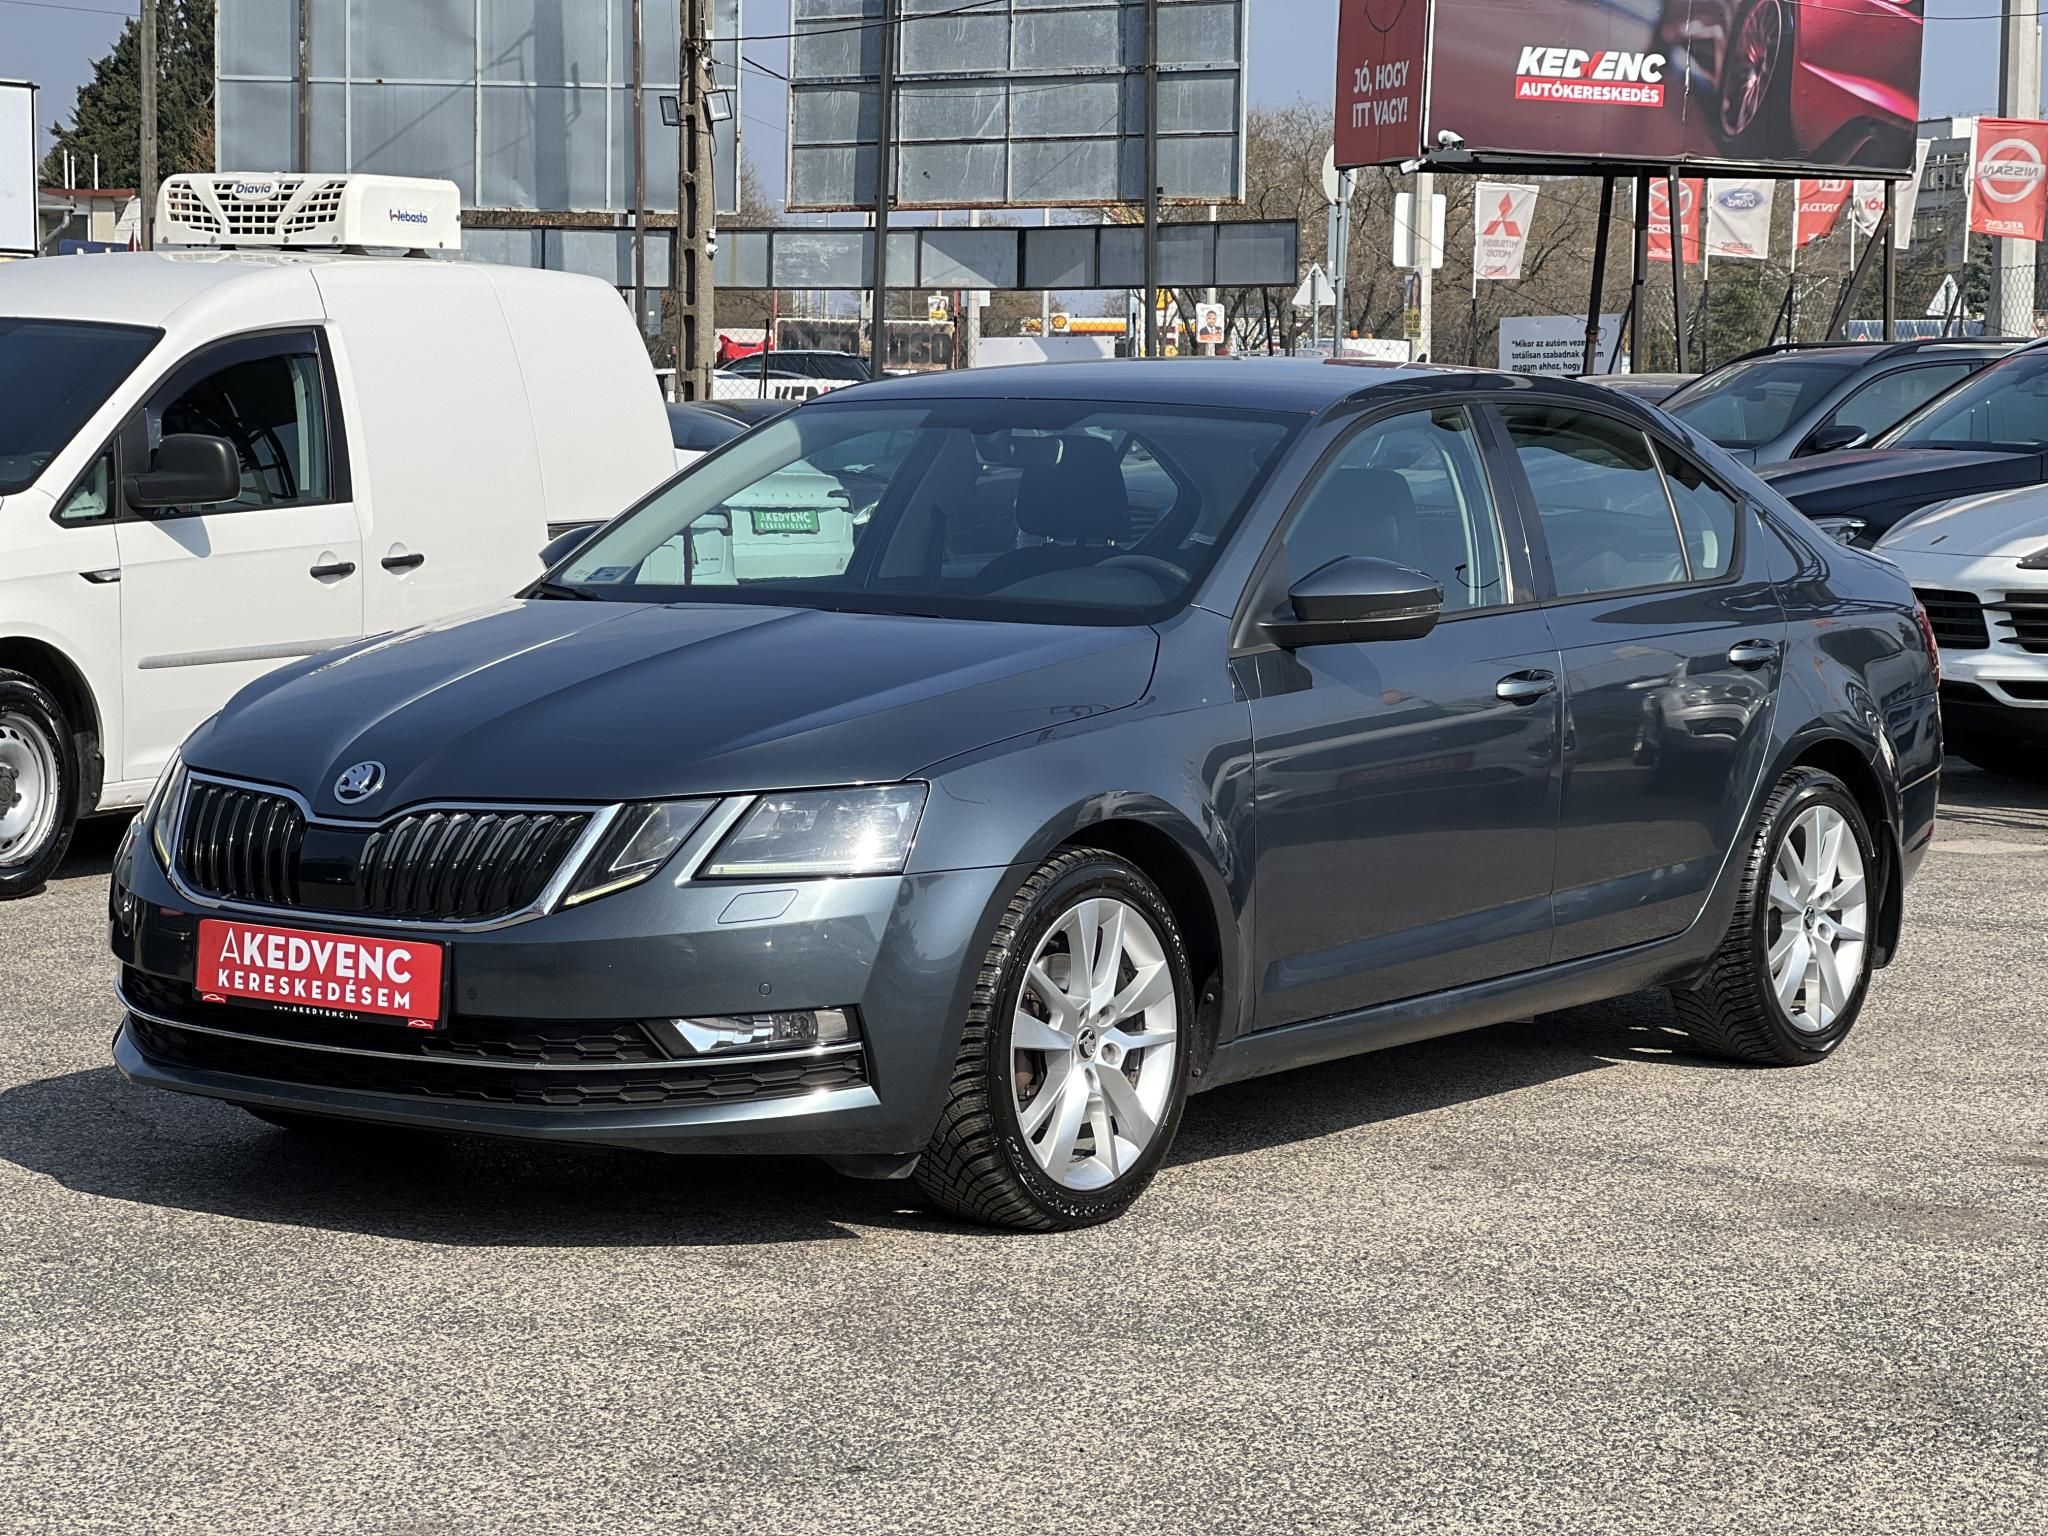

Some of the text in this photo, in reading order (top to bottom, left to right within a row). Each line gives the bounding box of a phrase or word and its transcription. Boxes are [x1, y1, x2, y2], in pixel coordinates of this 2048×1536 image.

[1353, 59, 1410, 94] JÓ, HOGY
[1519, 81, 1660, 104] AUTÓKERESKEDÉS
[1352, 97, 1409, 128] ITT VAGY!
[235, 182, 272, 195] Diavia
[389, 208, 428, 224] Webasto
[1545, 339, 1568, 347] autóm
[1511, 350, 1541, 359] totálisan
[1543, 349, 1580, 359] szabadnak
[1539, 362, 1562, 371] ahhoz,
[1563, 362, 1582, 371] hogy
[217, 968, 411, 1010] KERESKEDÉSEM
